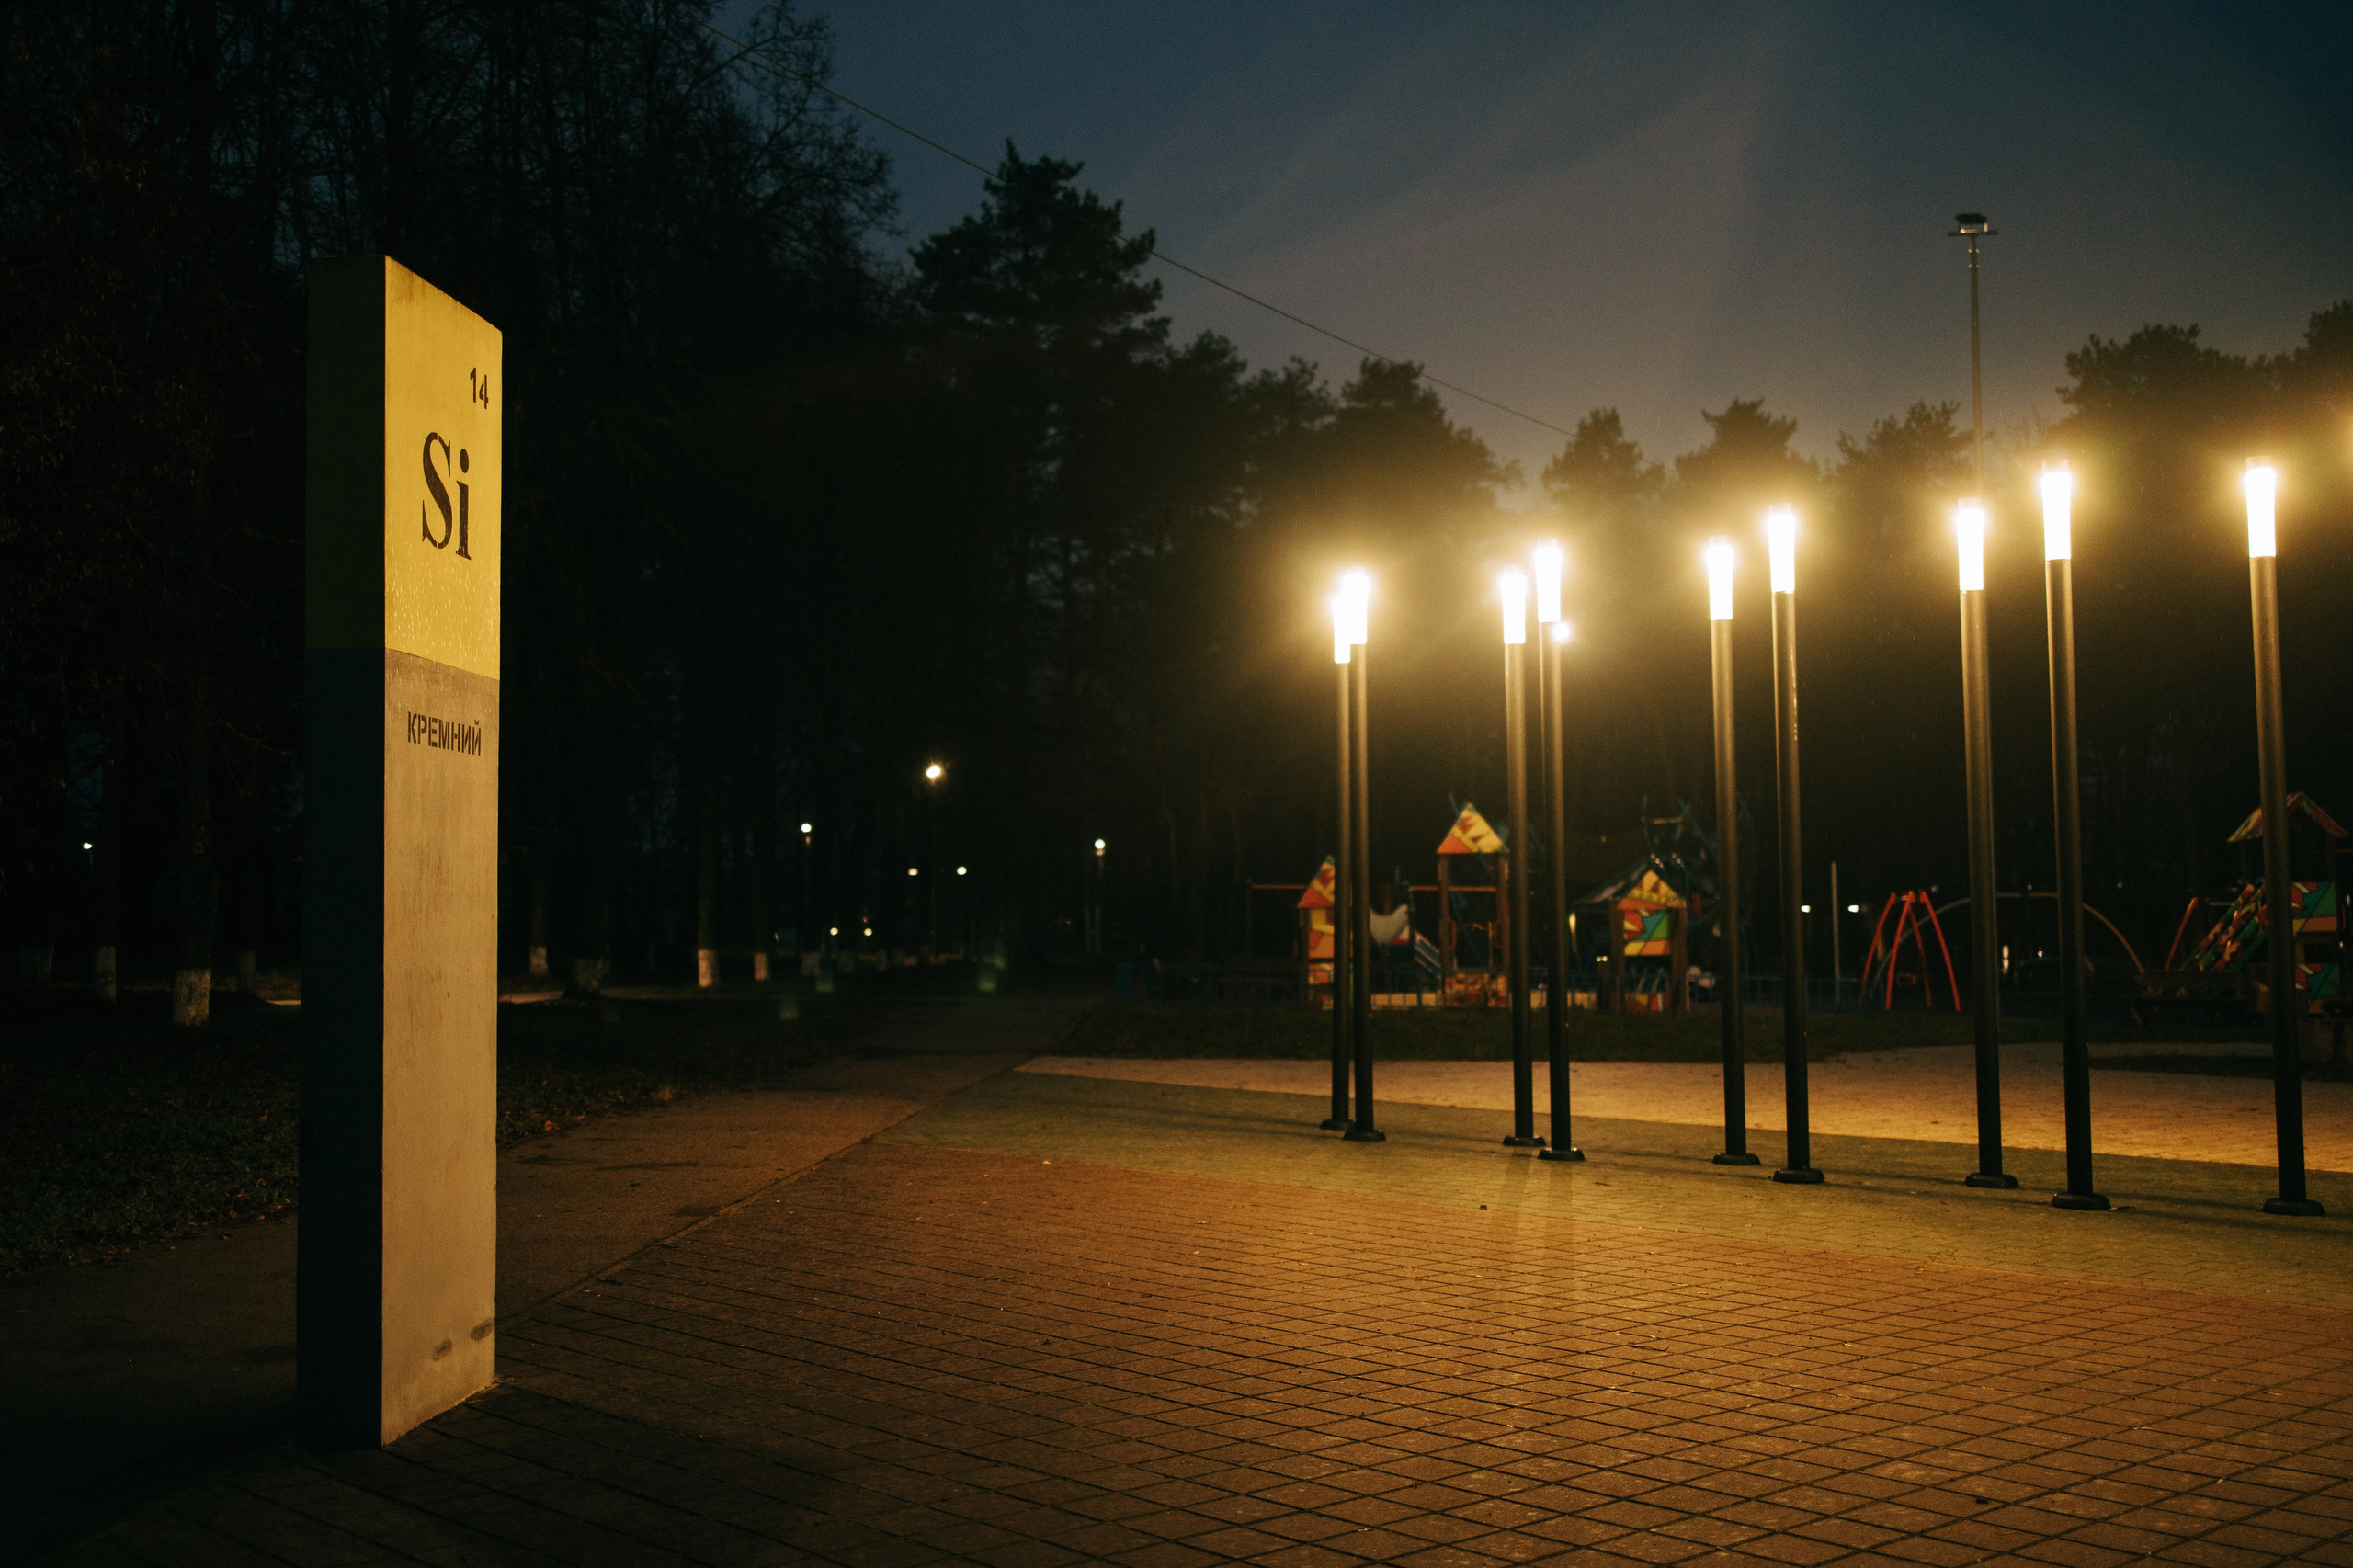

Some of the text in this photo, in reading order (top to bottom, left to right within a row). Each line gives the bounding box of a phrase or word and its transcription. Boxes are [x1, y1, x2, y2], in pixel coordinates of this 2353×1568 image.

[470, 367, 489, 410] 14
[422, 431, 472, 561] Si
[407, 710, 482, 756] КРЕМНИЙ
